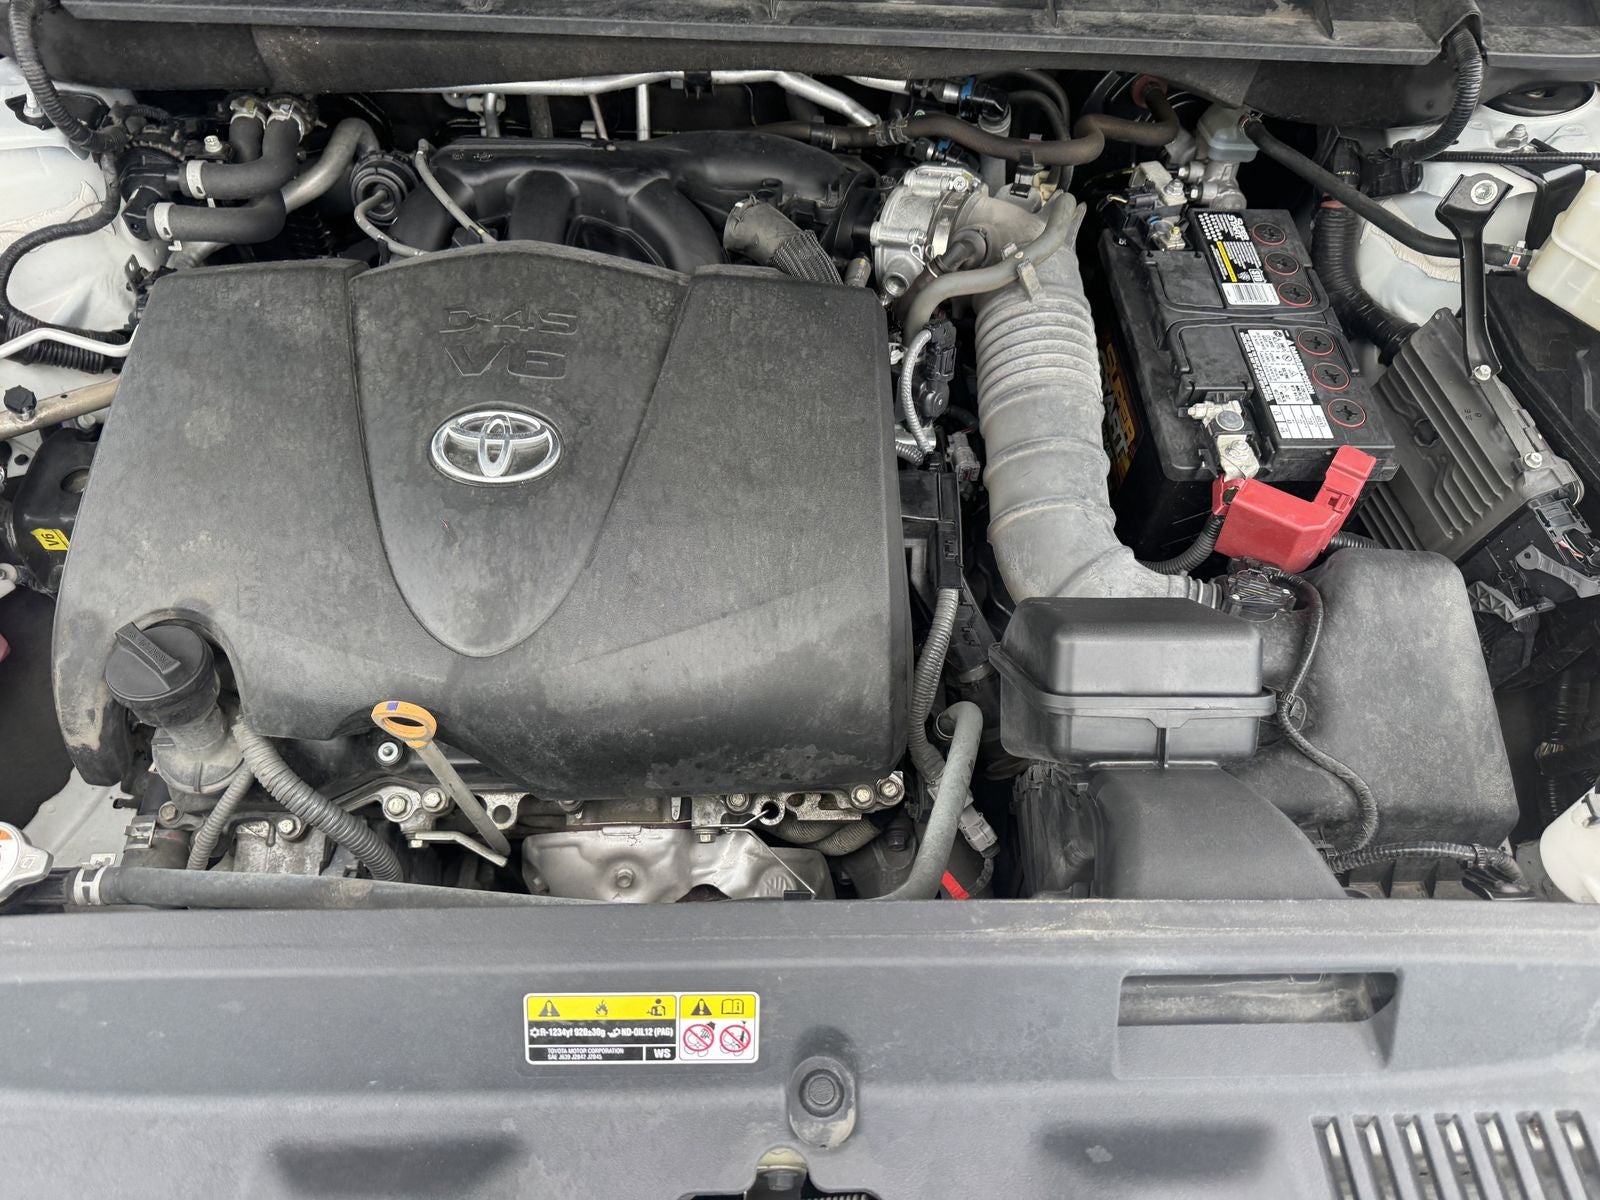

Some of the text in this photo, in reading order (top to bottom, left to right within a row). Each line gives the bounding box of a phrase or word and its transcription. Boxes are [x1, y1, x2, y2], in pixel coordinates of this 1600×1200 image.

[439, 305, 578, 336] D-4S
[440, 343, 567, 379] V6
[1105, 342, 1136, 447] SUPER
[653, 1048, 671, 1058] WS
